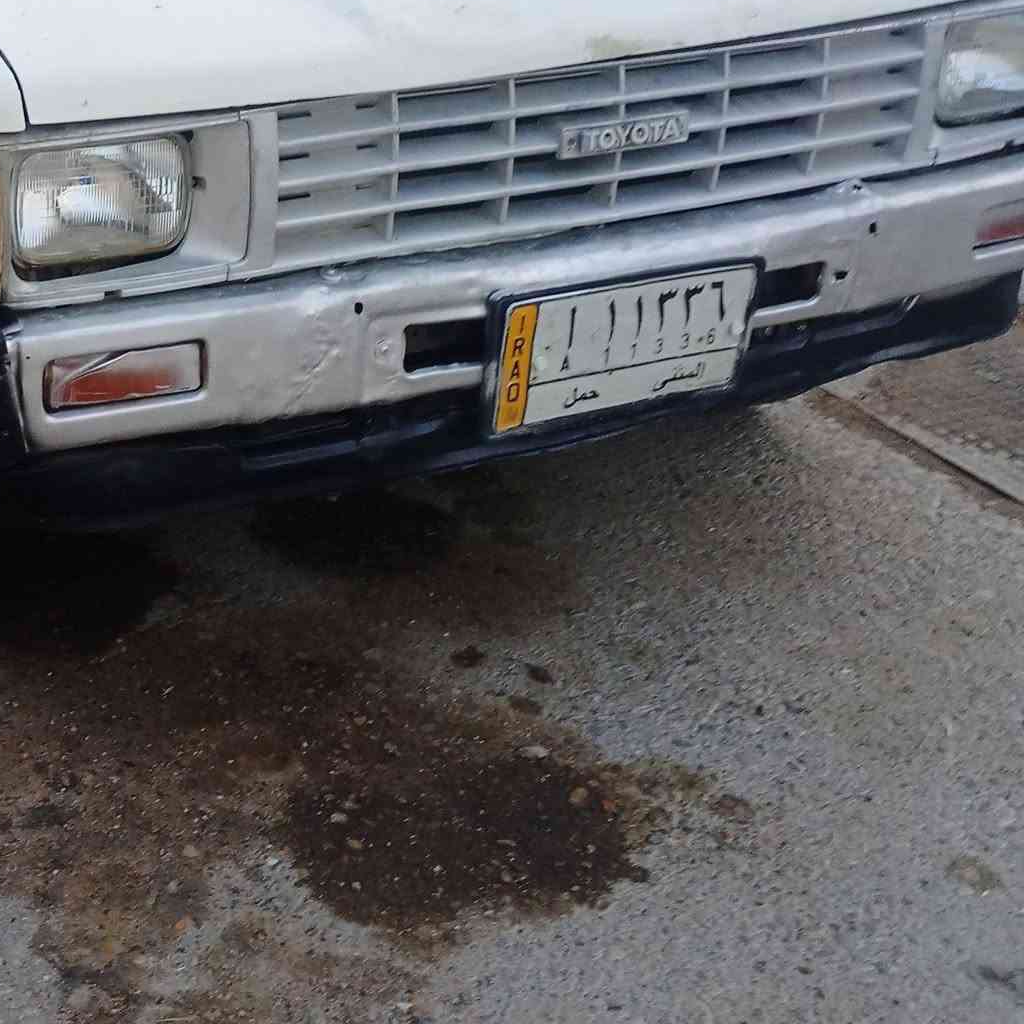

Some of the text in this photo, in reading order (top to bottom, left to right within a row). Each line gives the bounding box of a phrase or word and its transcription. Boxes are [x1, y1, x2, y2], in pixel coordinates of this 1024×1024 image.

[589, 119, 682, 153] TOYOTA
[506, 315, 526, 403] IRAQ
[564, 387, 600, 409] حمل
